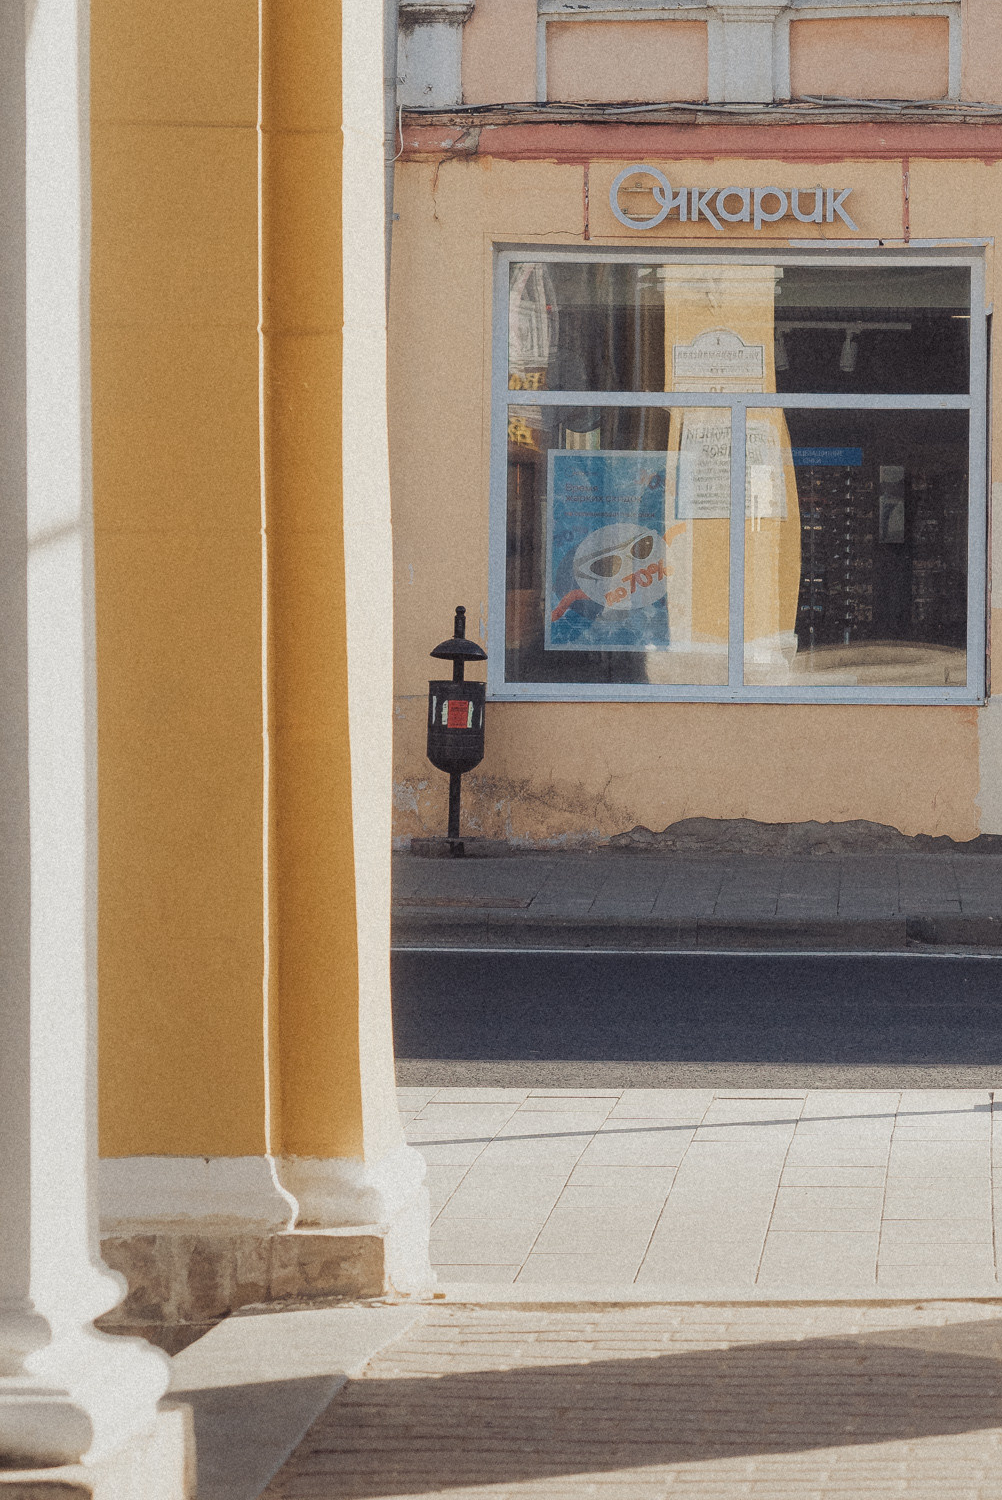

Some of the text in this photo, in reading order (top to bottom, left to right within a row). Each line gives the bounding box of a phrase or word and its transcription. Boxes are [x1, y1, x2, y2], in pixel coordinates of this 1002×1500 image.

[609, 164, 859, 231] Очкарик
[565, 482, 599, 493] Время
[565, 495, 602, 504] жарких
[621, 559, 675, 594] 70%
